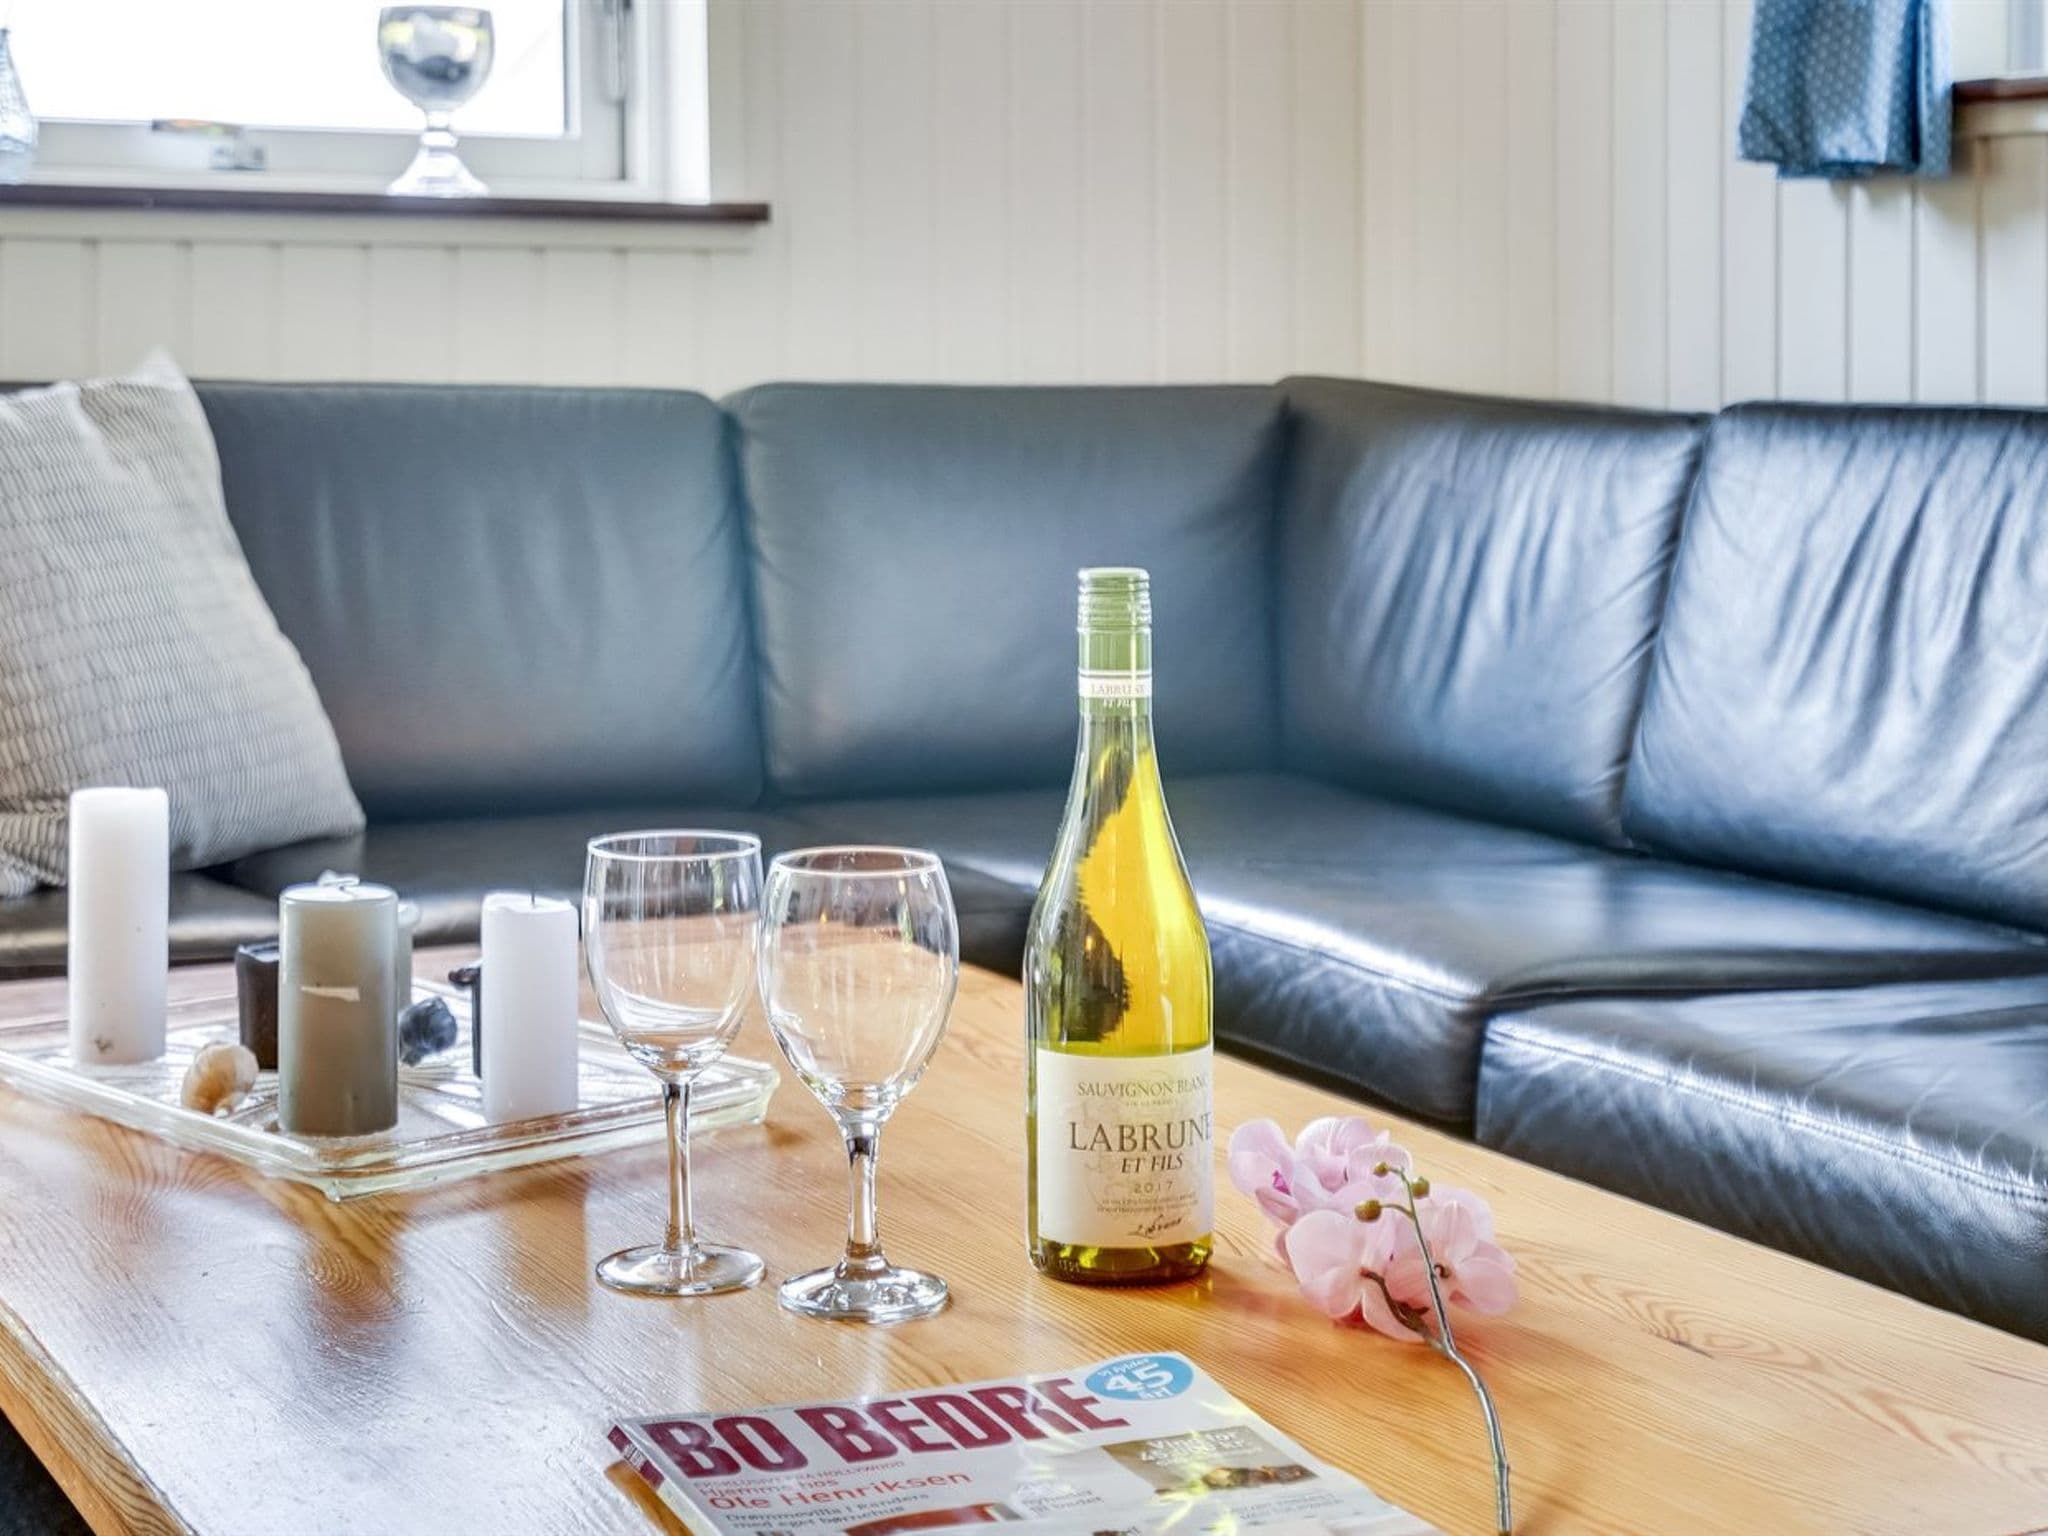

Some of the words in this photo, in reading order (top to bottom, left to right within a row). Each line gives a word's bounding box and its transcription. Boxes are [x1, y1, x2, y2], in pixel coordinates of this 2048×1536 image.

[1077, 1080, 1174, 1098] SAUVIGNON
[1121, 1156, 1146, 1174] ET
[1151, 1152, 1184, 1172] FILS
[1104, 1362, 1174, 1392] 45
[642, 1415, 810, 1480] BO
[793, 1377, 1132, 1464] BEDRE
[709, 1496, 771, 1510] Ole
[779, 1472, 973, 1507] Henriksen
